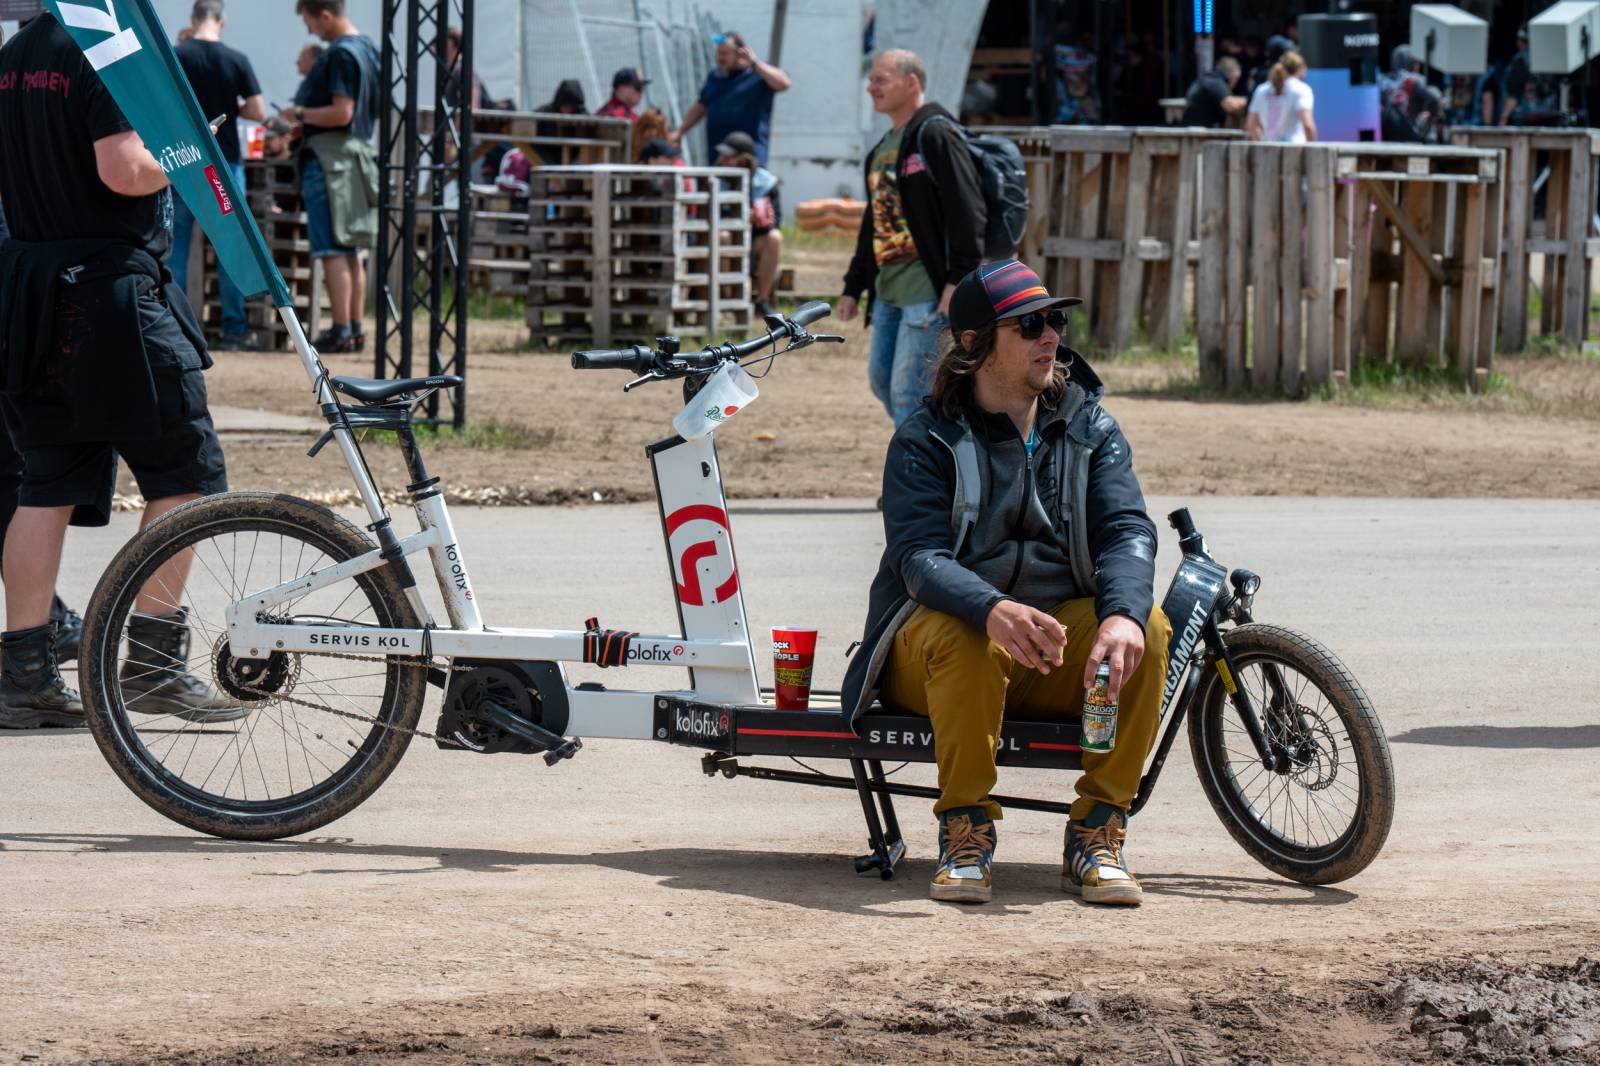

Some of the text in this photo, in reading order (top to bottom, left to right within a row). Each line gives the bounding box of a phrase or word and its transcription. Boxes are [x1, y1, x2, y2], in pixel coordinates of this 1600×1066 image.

[445, 543, 468, 592] koofix
[309, 633, 410, 648] SERVIS KOL
[773, 641, 789, 649] OCK
[627, 643, 671, 661] olofix
[1160, 599, 1208, 720] ERGAMONT
[676, 707, 719, 737] kolofix
[869, 730, 1021, 751] SERV OL
